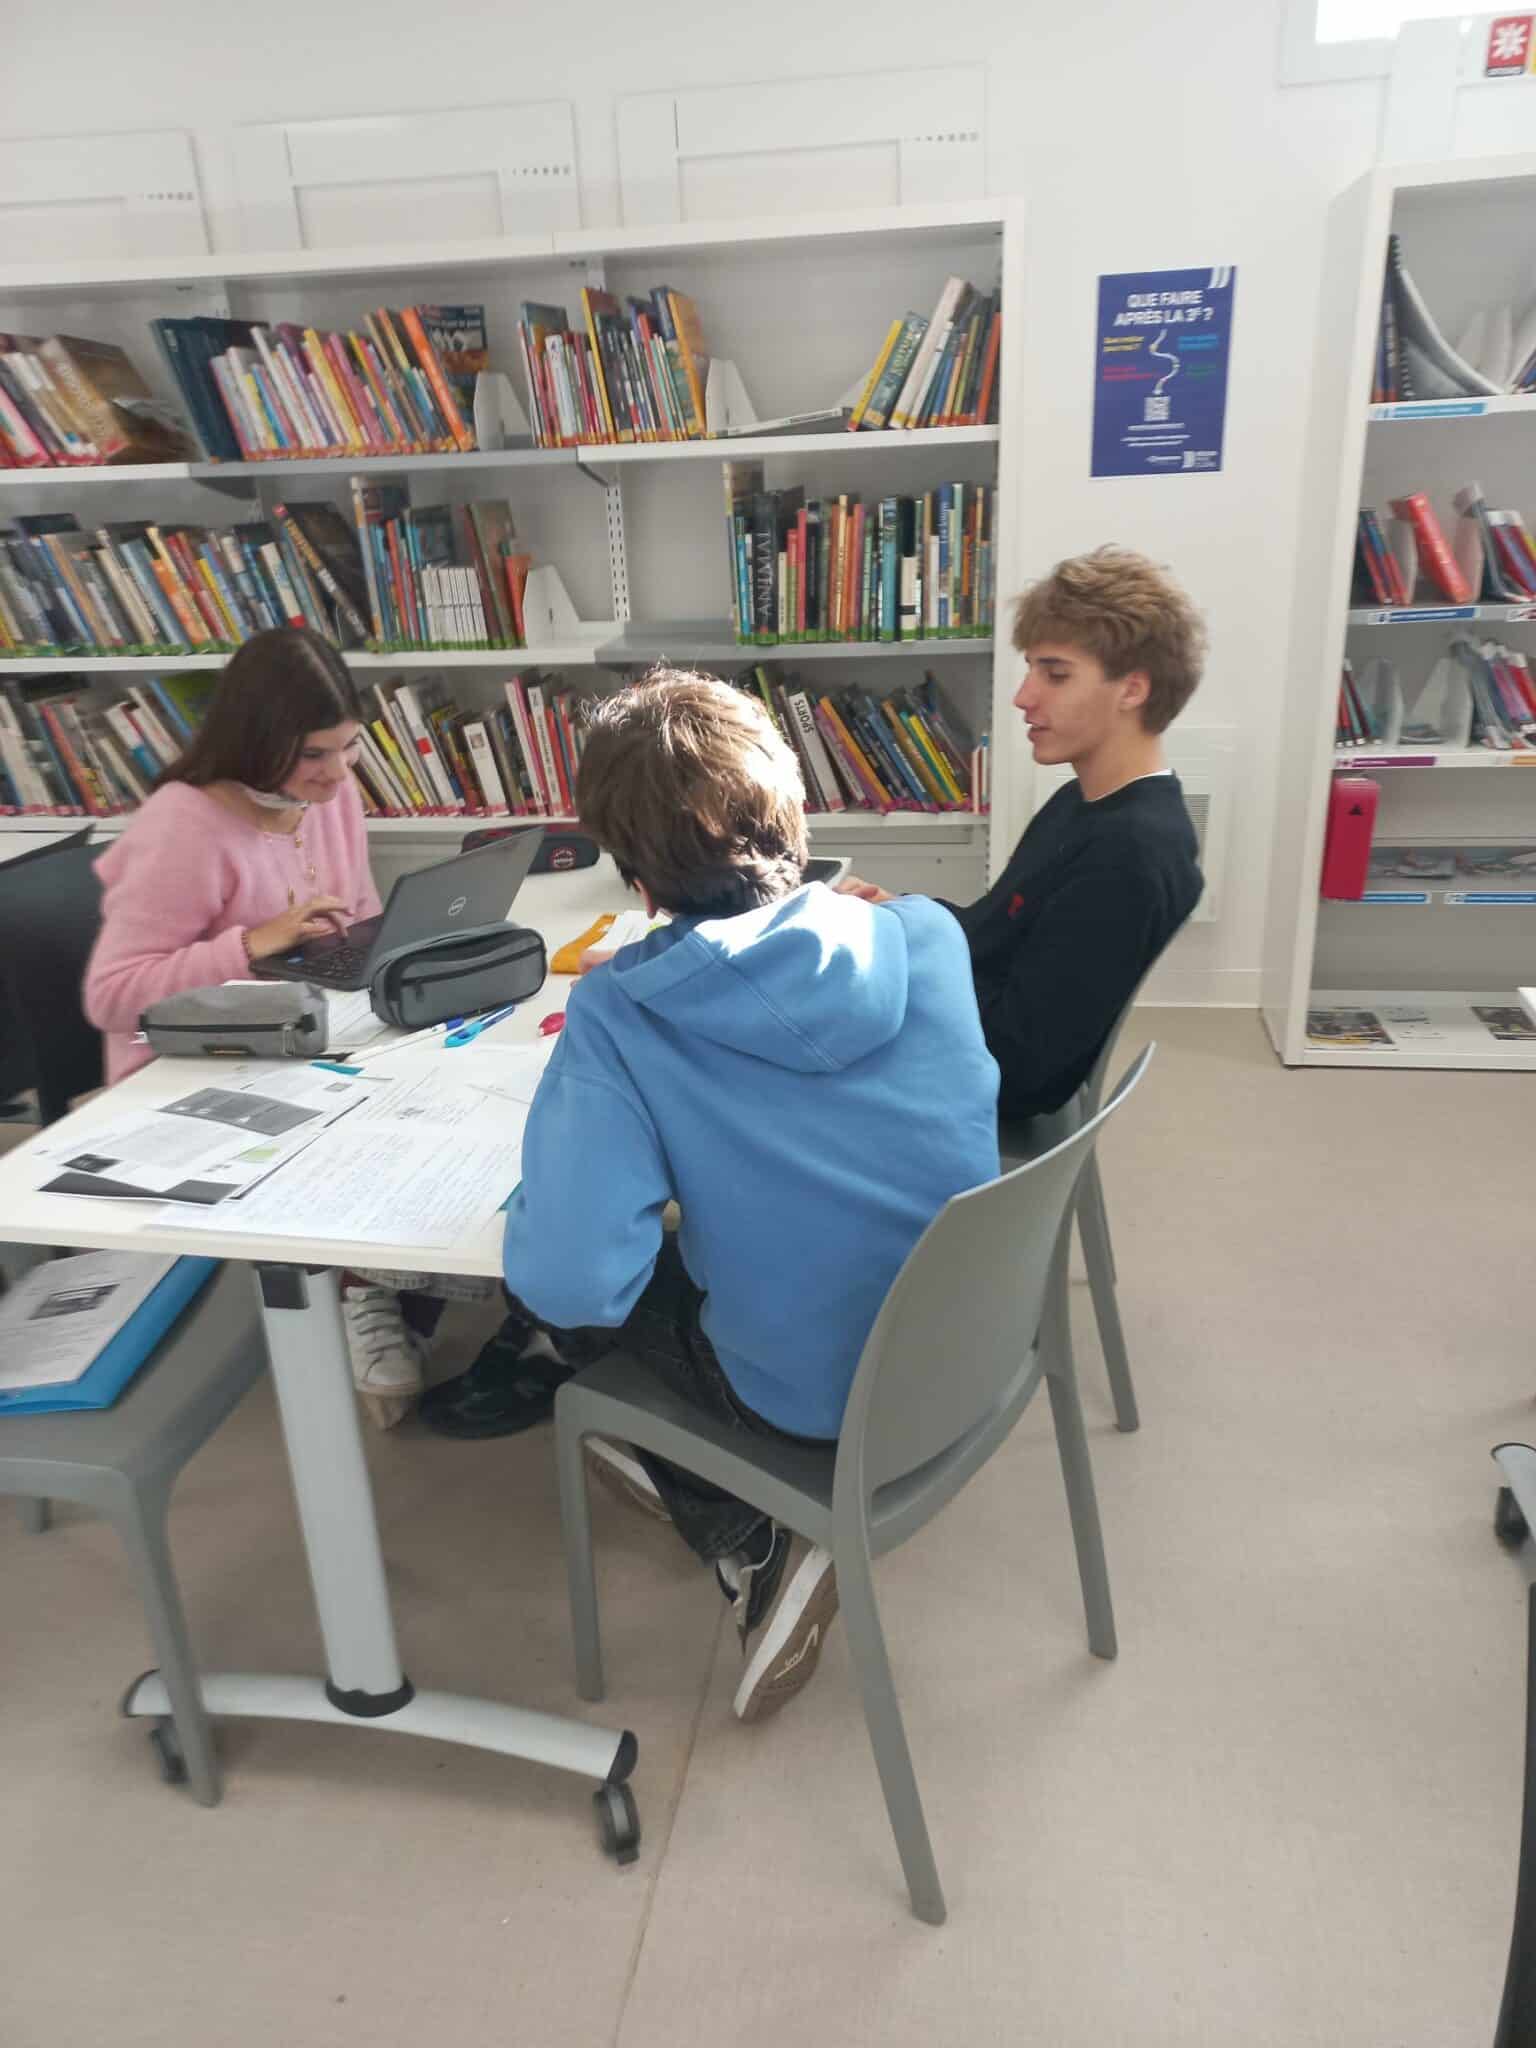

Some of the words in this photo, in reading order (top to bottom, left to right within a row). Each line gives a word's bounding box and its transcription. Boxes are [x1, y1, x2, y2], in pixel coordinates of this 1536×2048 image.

[1127, 293, 1159, 308] QUE
[1160, 290, 1203, 305] FAIRE
[1164, 309, 1184, 324] LA
[756, 529, 773, 617] ANIMAL
[794, 699, 814, 733] SPORTS
